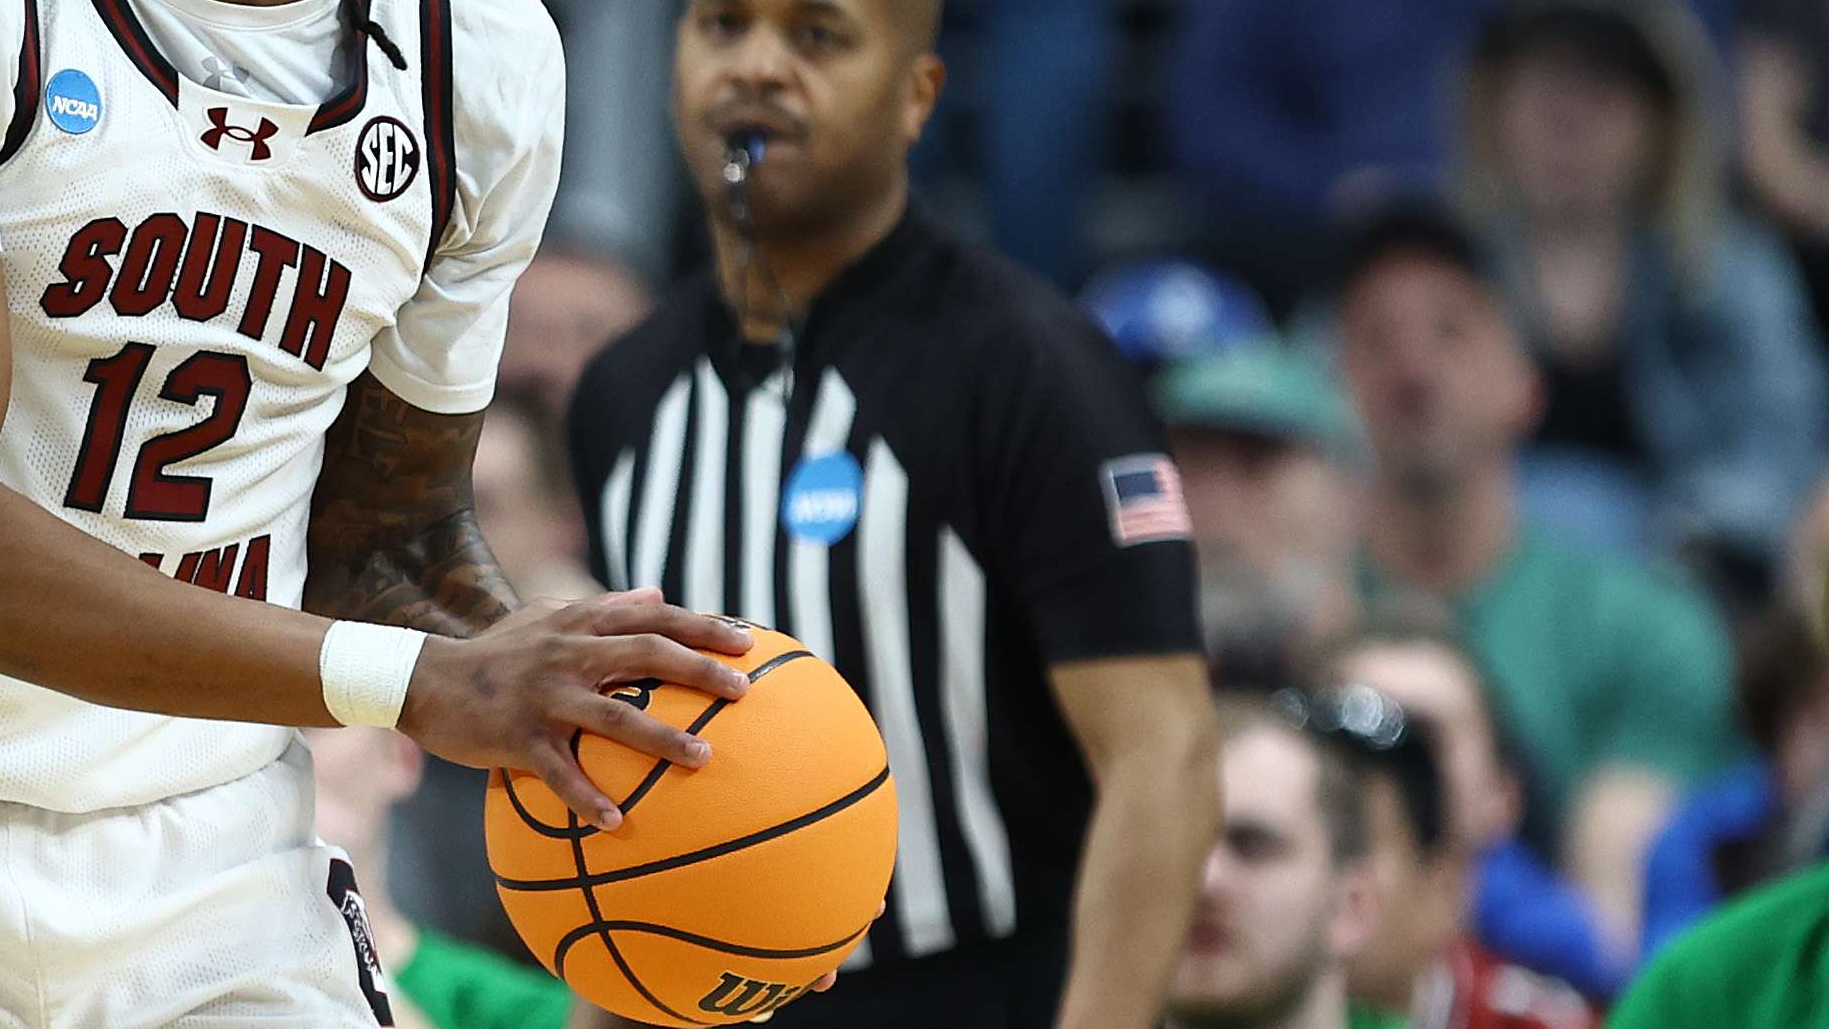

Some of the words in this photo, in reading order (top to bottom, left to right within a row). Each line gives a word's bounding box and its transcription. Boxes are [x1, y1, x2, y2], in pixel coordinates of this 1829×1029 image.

[52, 94, 99, 122] NCAA
[361, 122, 414, 195] SEC
[39, 211, 352, 371] SOUTH
[62, 342, 253, 522] 12
